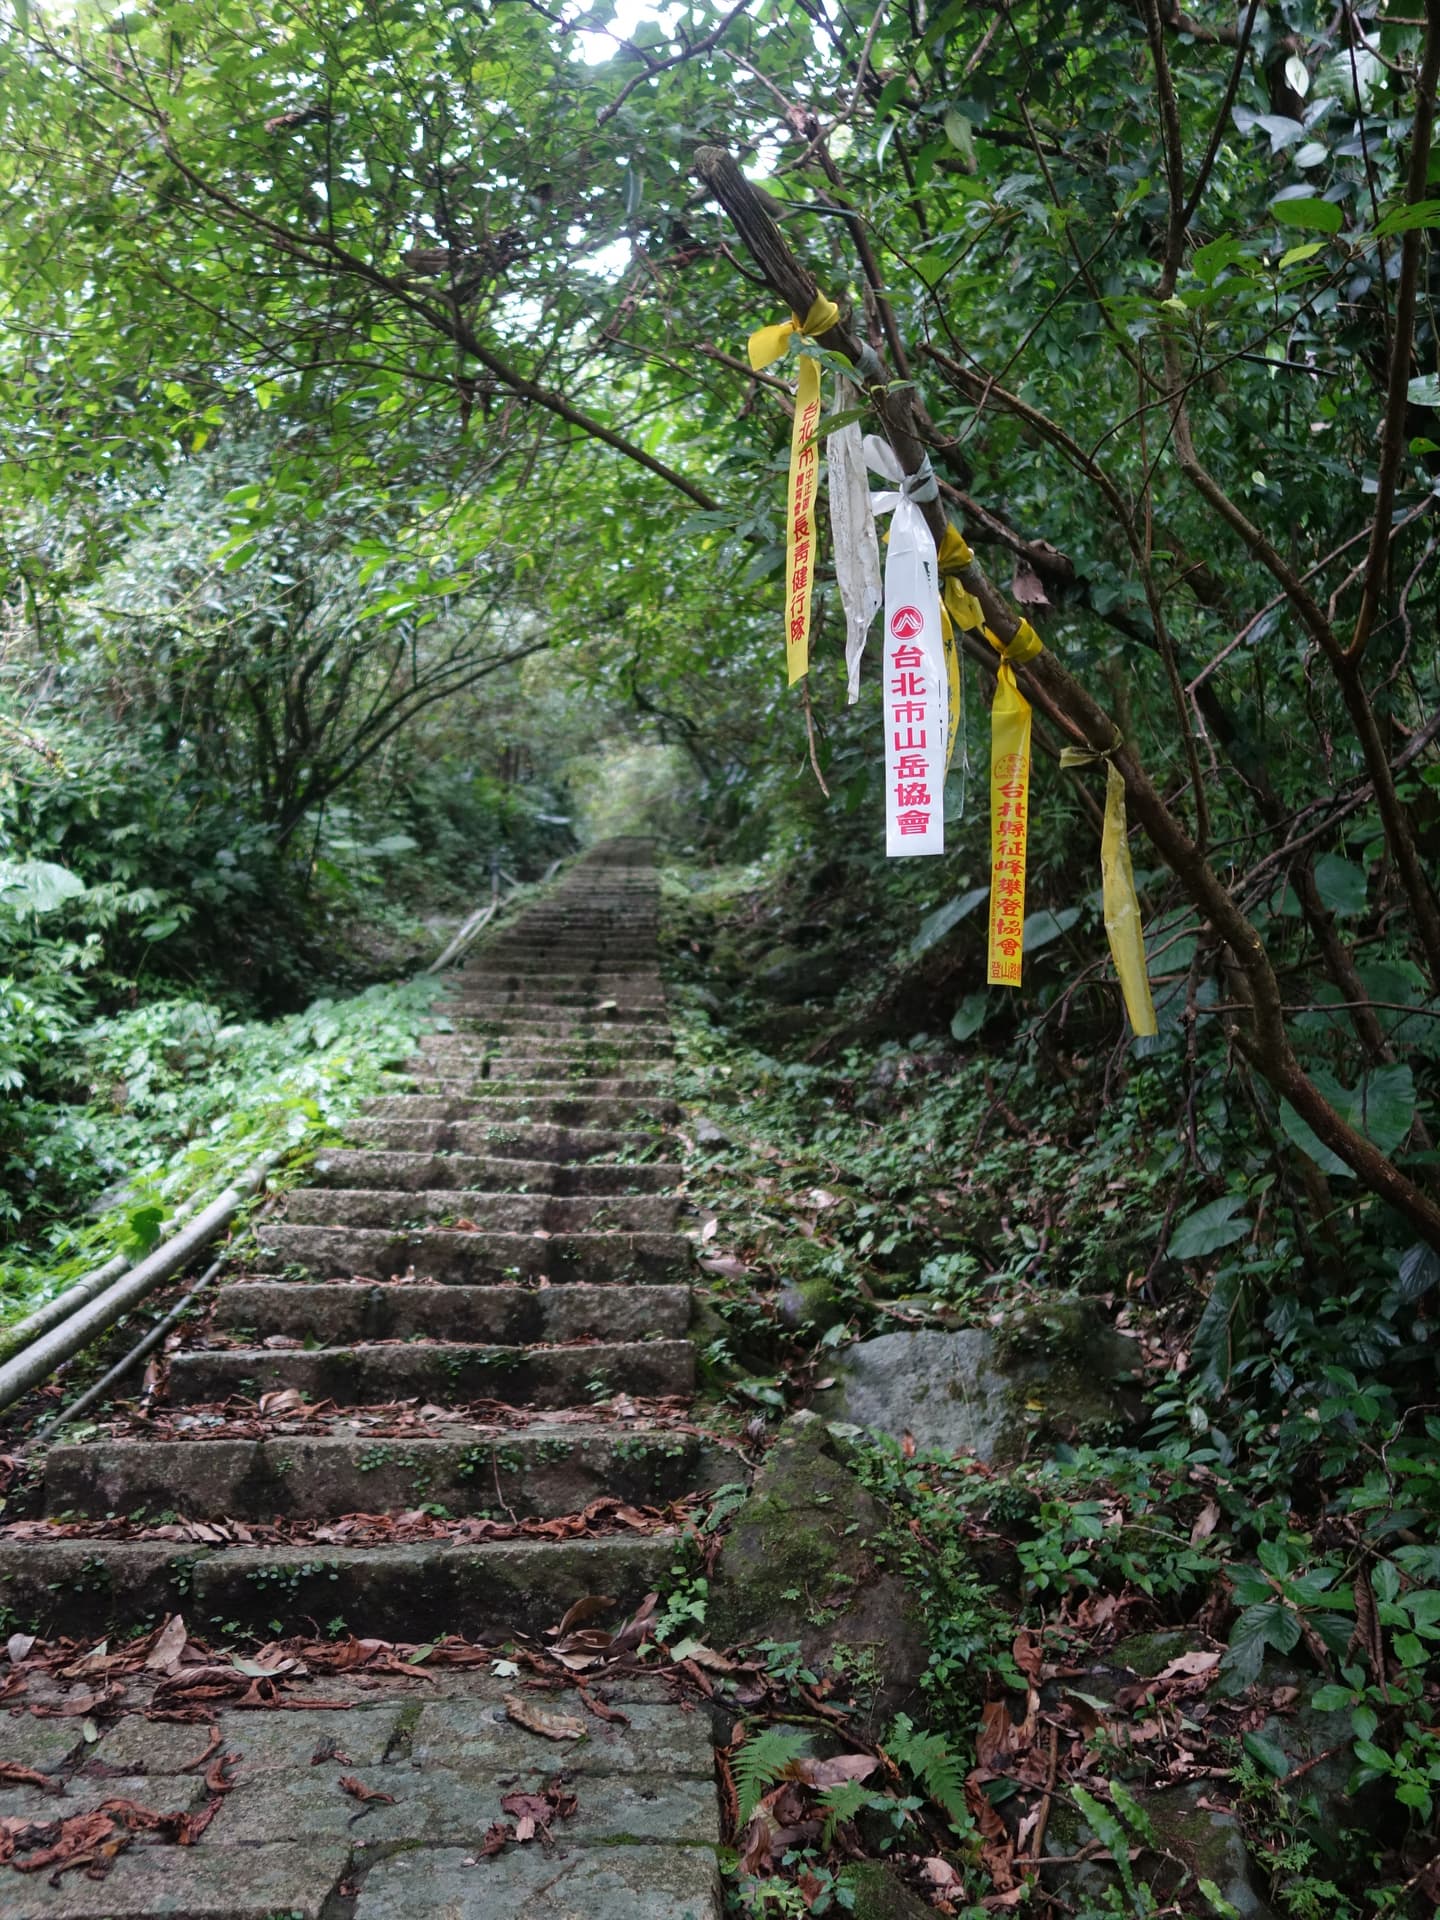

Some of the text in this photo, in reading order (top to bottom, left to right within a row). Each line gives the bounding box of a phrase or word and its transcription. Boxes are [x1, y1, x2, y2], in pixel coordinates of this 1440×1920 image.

[891, 644, 931, 835] 台北市山岳協會
